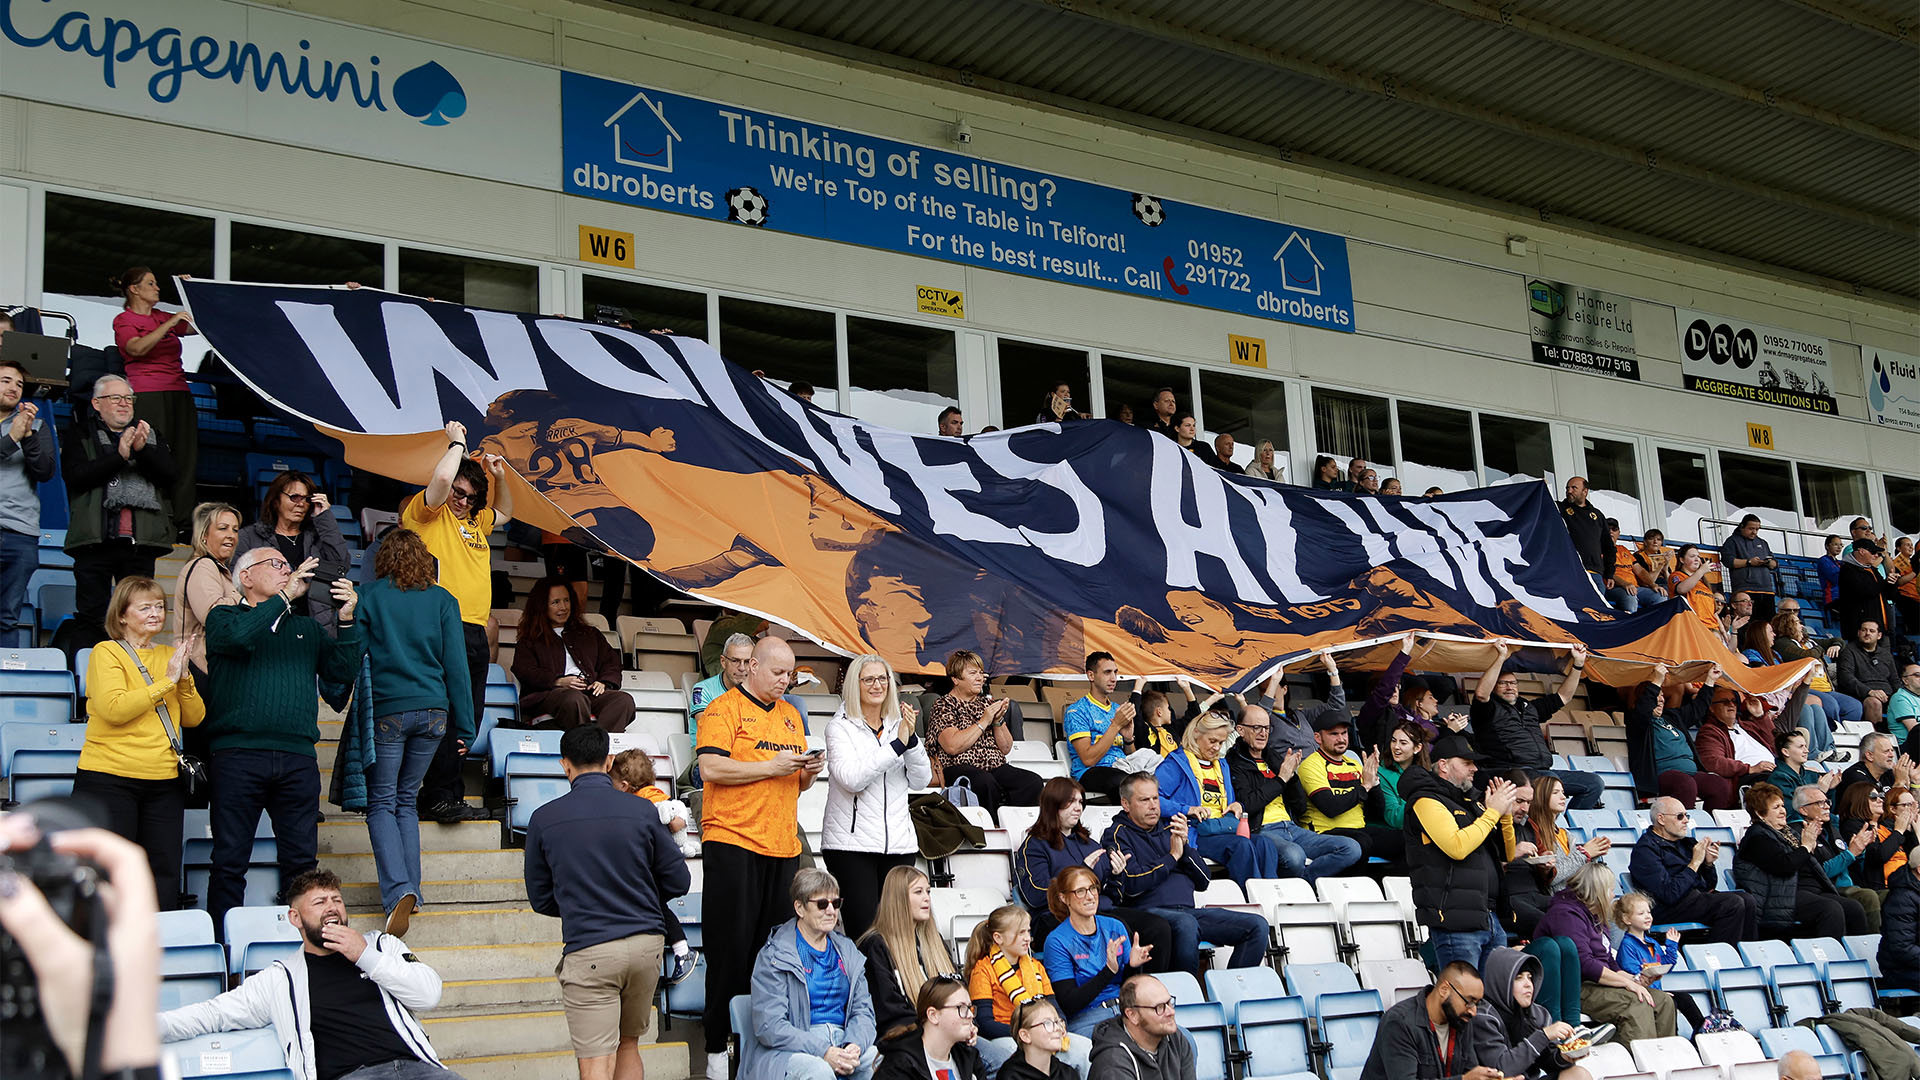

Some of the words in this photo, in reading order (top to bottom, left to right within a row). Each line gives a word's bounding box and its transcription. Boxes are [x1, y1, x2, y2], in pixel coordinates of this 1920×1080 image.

[0, 0, 388, 112] Capgemini
[718, 110, 876, 178] Thinking
[887, 150, 921, 180] of
[933, 162, 1058, 212] selling?
[573, 163, 715, 210] dbroberts
[769, 165, 838, 197] We're
[844, 179, 887, 210] Top
[894, 191, 917, 211] of
[922, 196, 957, 220] the
[962, 202, 1020, 233] Table
[1026, 215, 1044, 238] in
[1049, 220, 1127, 254] Telford!
[906, 225, 944, 253] For
[951, 234, 985, 260] the
[991, 241, 1037, 270] best
[1042, 256, 1118, 284] result...
[1124, 265, 1162, 291] Call
[1187, 239, 1244, 268] 01952
[1184, 262, 1252, 293] 291722
[918, 288, 948, 302] CCTV
[921, 305, 947, 313] OPERATION
[1256, 291, 1350, 326] dbroberts
[1566, 305, 1612, 329] Leisure
[1614, 316, 1633, 334] Ltd
[1556, 330, 1585, 344] Caravan
[1585, 335, 1603, 348] Sales
[1604, 340, 1611, 349] &
[1690, 328, 1754, 361] DRM
[1763, 334, 1790, 349] 01952
[1791, 340, 1824, 356] 770056
[1542, 345, 1560, 359] Tel:
[1561, 349, 1594, 365] 07883
[1596, 356, 1612, 369] 177
[1614, 359, 1632, 372] 516
[1763, 348, 1827, 367] www.drmaggregates.com
[1889, 360, 1916, 379] Fluid
[1695, 378, 1756, 400] AGGREGATE
[1757, 389, 1811, 409] SOLUTIONS
[1812, 399, 1831, 412] LTD
[275, 299, 1106, 567] WOLVES
[1288, 598, 1361, 620] 1975
[754, 740, 803, 755] MIDNITE
